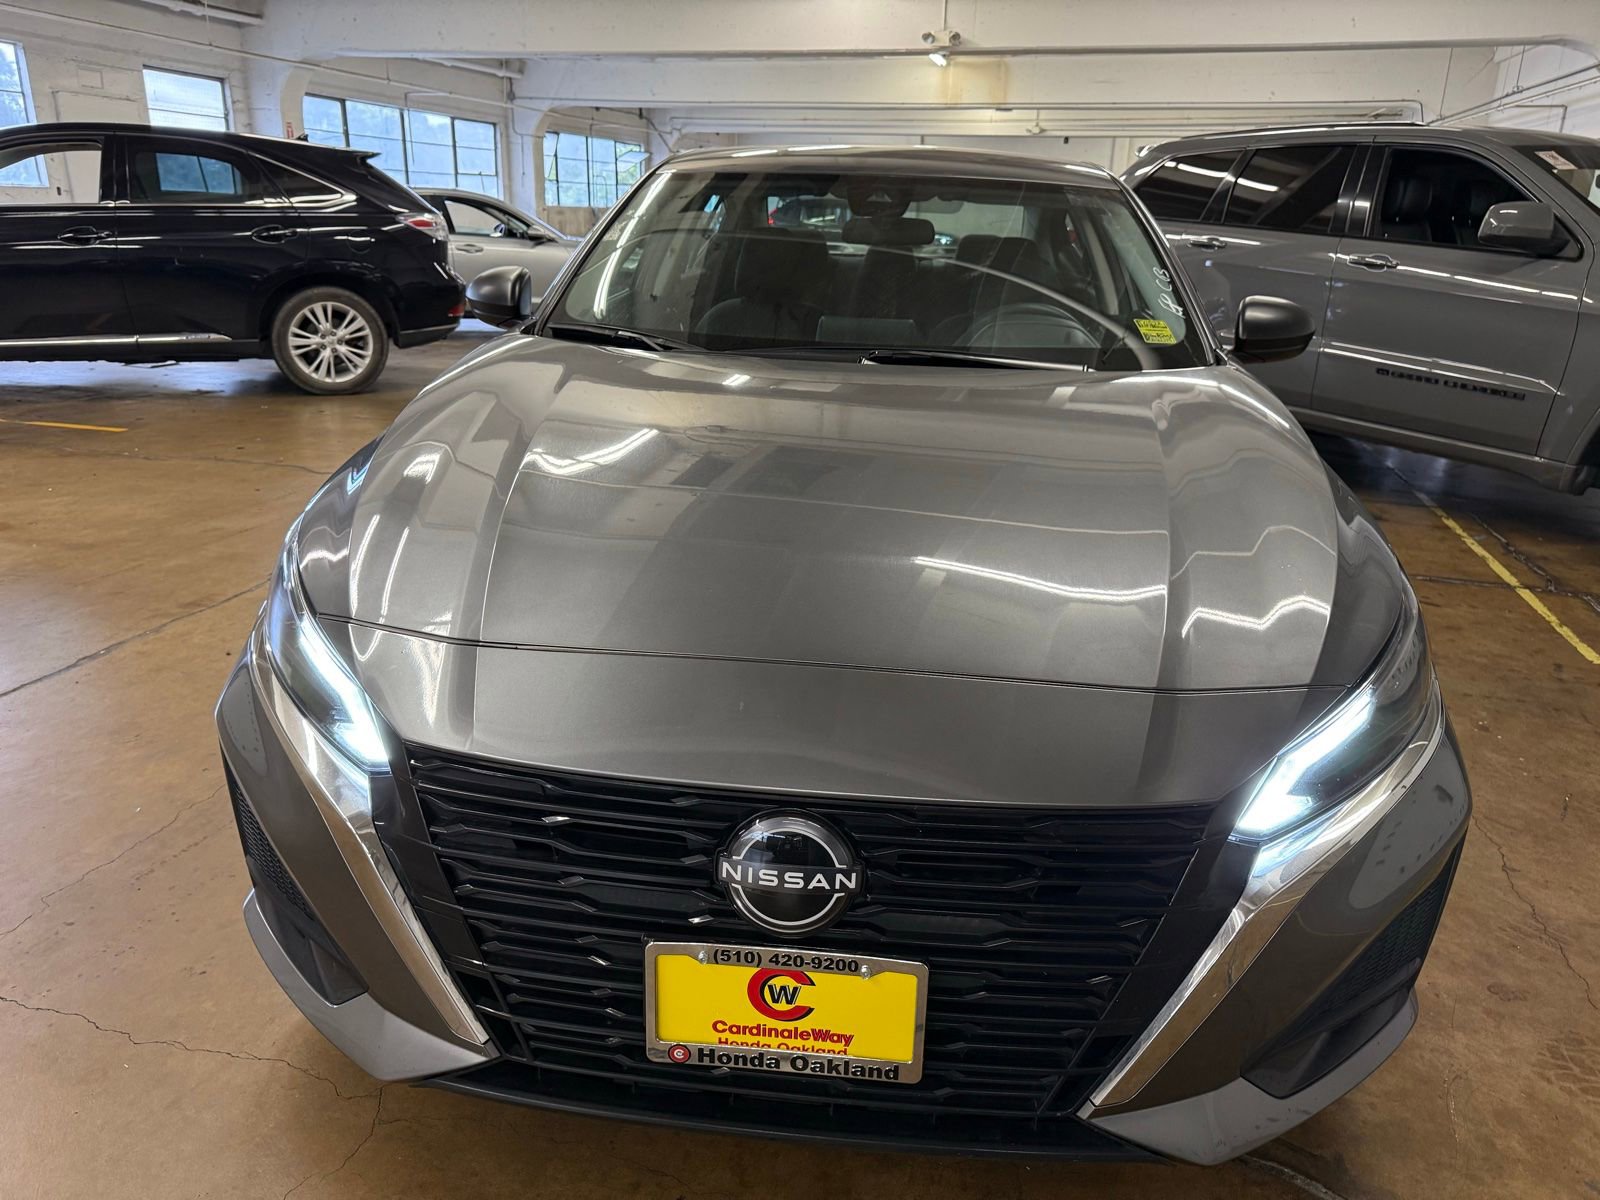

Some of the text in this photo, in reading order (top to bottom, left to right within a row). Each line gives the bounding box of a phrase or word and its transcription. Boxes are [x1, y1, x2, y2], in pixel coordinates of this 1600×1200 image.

[722, 861, 857, 890] NISSAN
[713, 949, 859, 973] (510) 420-9200
[712, 1020, 854, 1047] CardinaleWay
[698, 1047, 899, 1081] Honda Oakland
